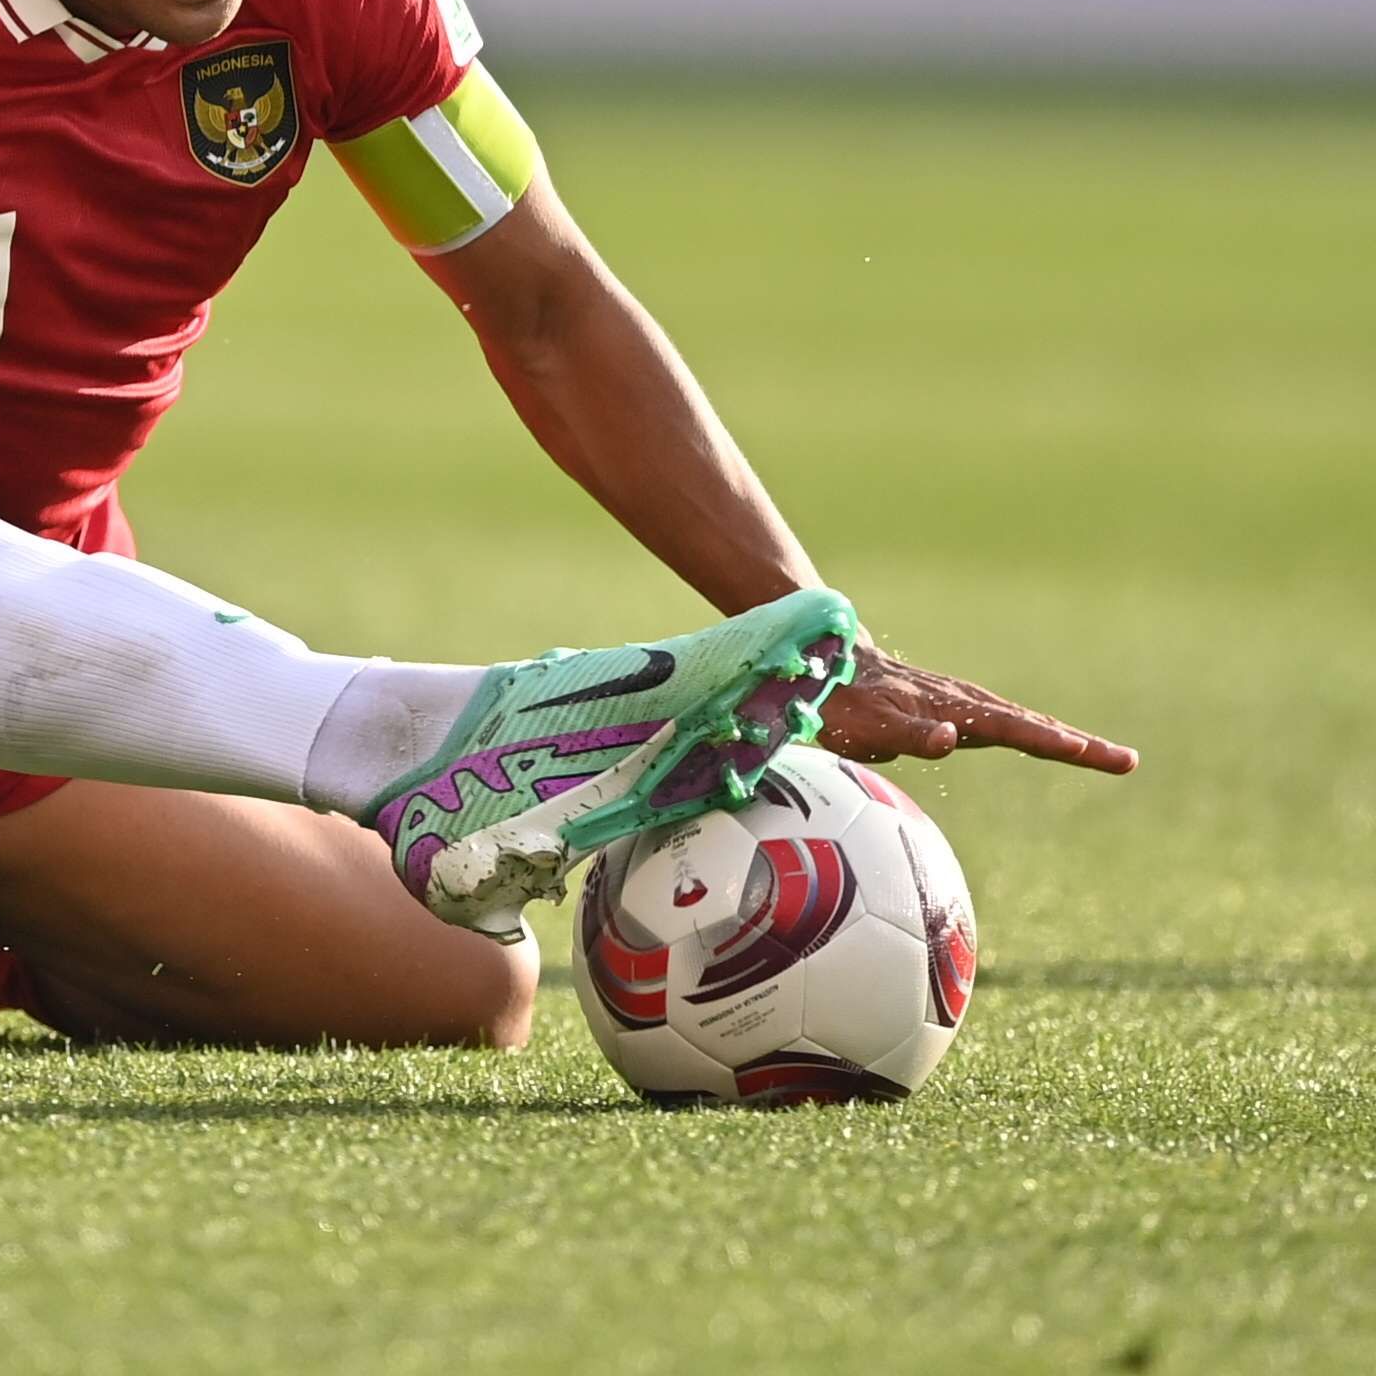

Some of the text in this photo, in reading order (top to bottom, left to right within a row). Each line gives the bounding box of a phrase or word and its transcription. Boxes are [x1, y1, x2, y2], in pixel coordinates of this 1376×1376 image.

[196, 53, 274, 81] INDONESIA
[743, 984, 779, 1007] AUSTRALIA
[698, 1008, 735, 1029] INDONESIA
